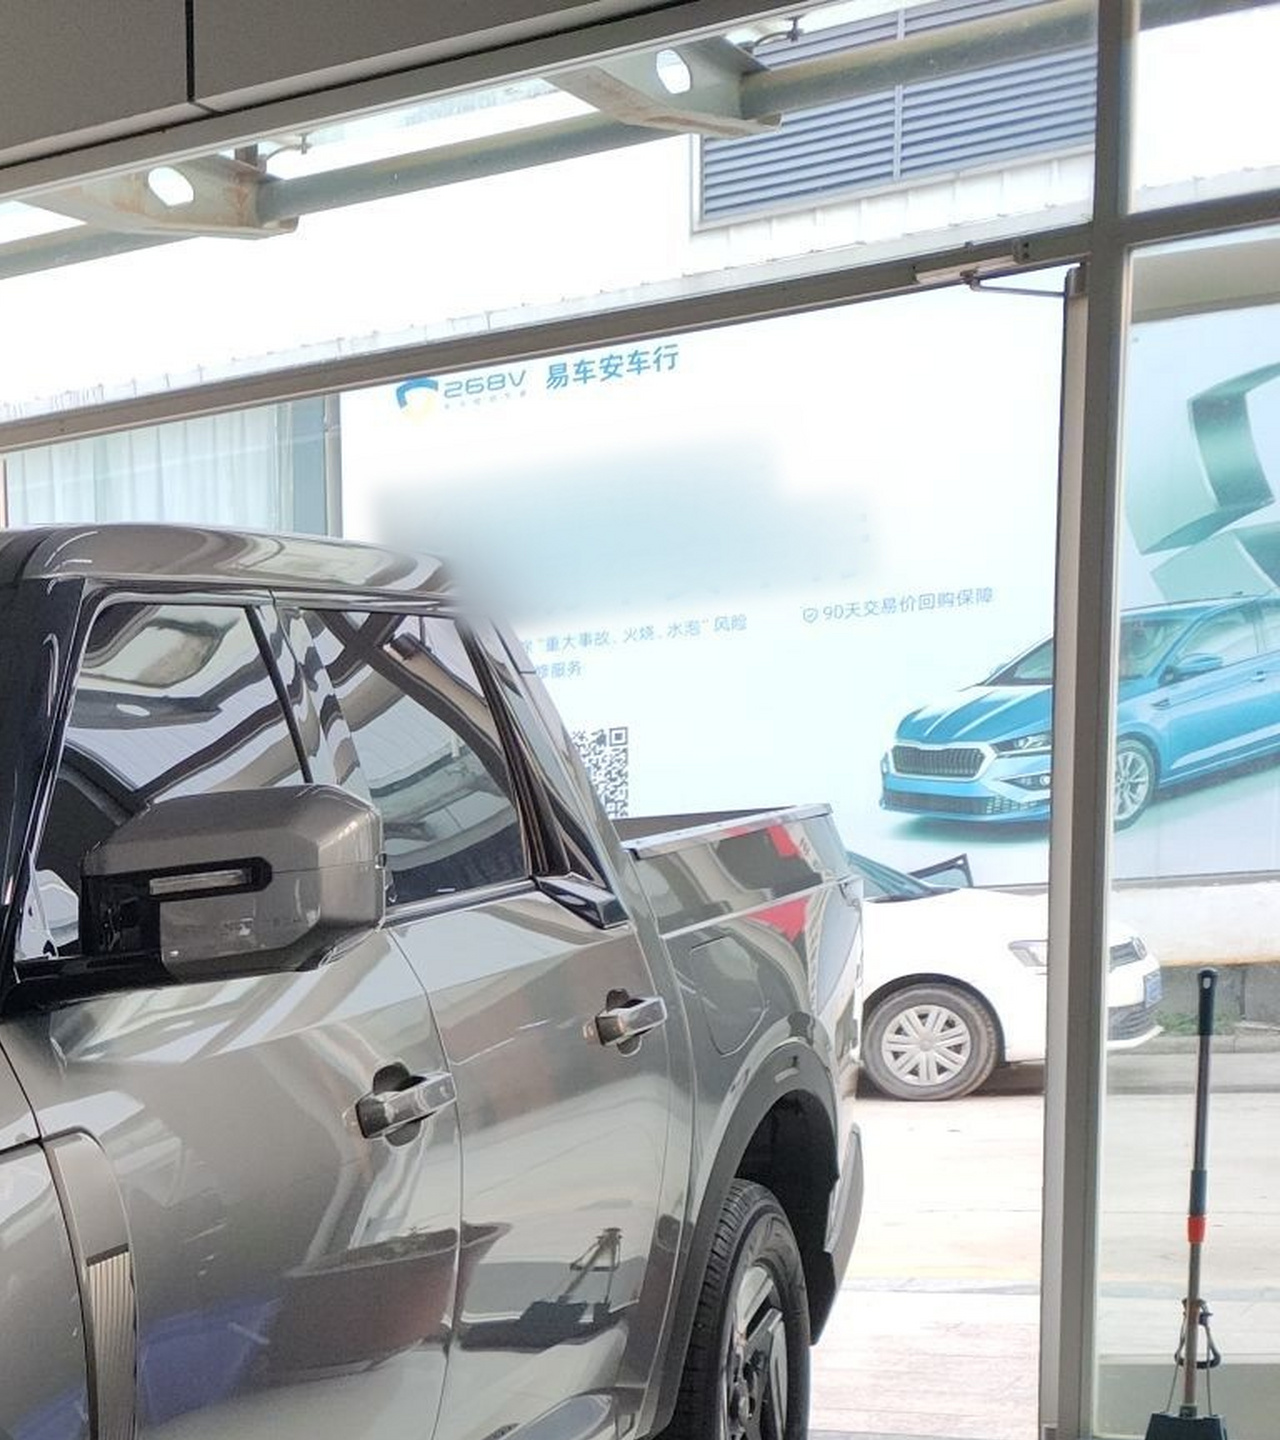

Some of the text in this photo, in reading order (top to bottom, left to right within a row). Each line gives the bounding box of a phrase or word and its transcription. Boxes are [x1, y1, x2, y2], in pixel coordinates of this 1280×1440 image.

[444, 370, 526, 399] 268V
[546, 344, 679, 390] 易车安车行
[823, 587, 993, 620] 90天交易价回购保障
